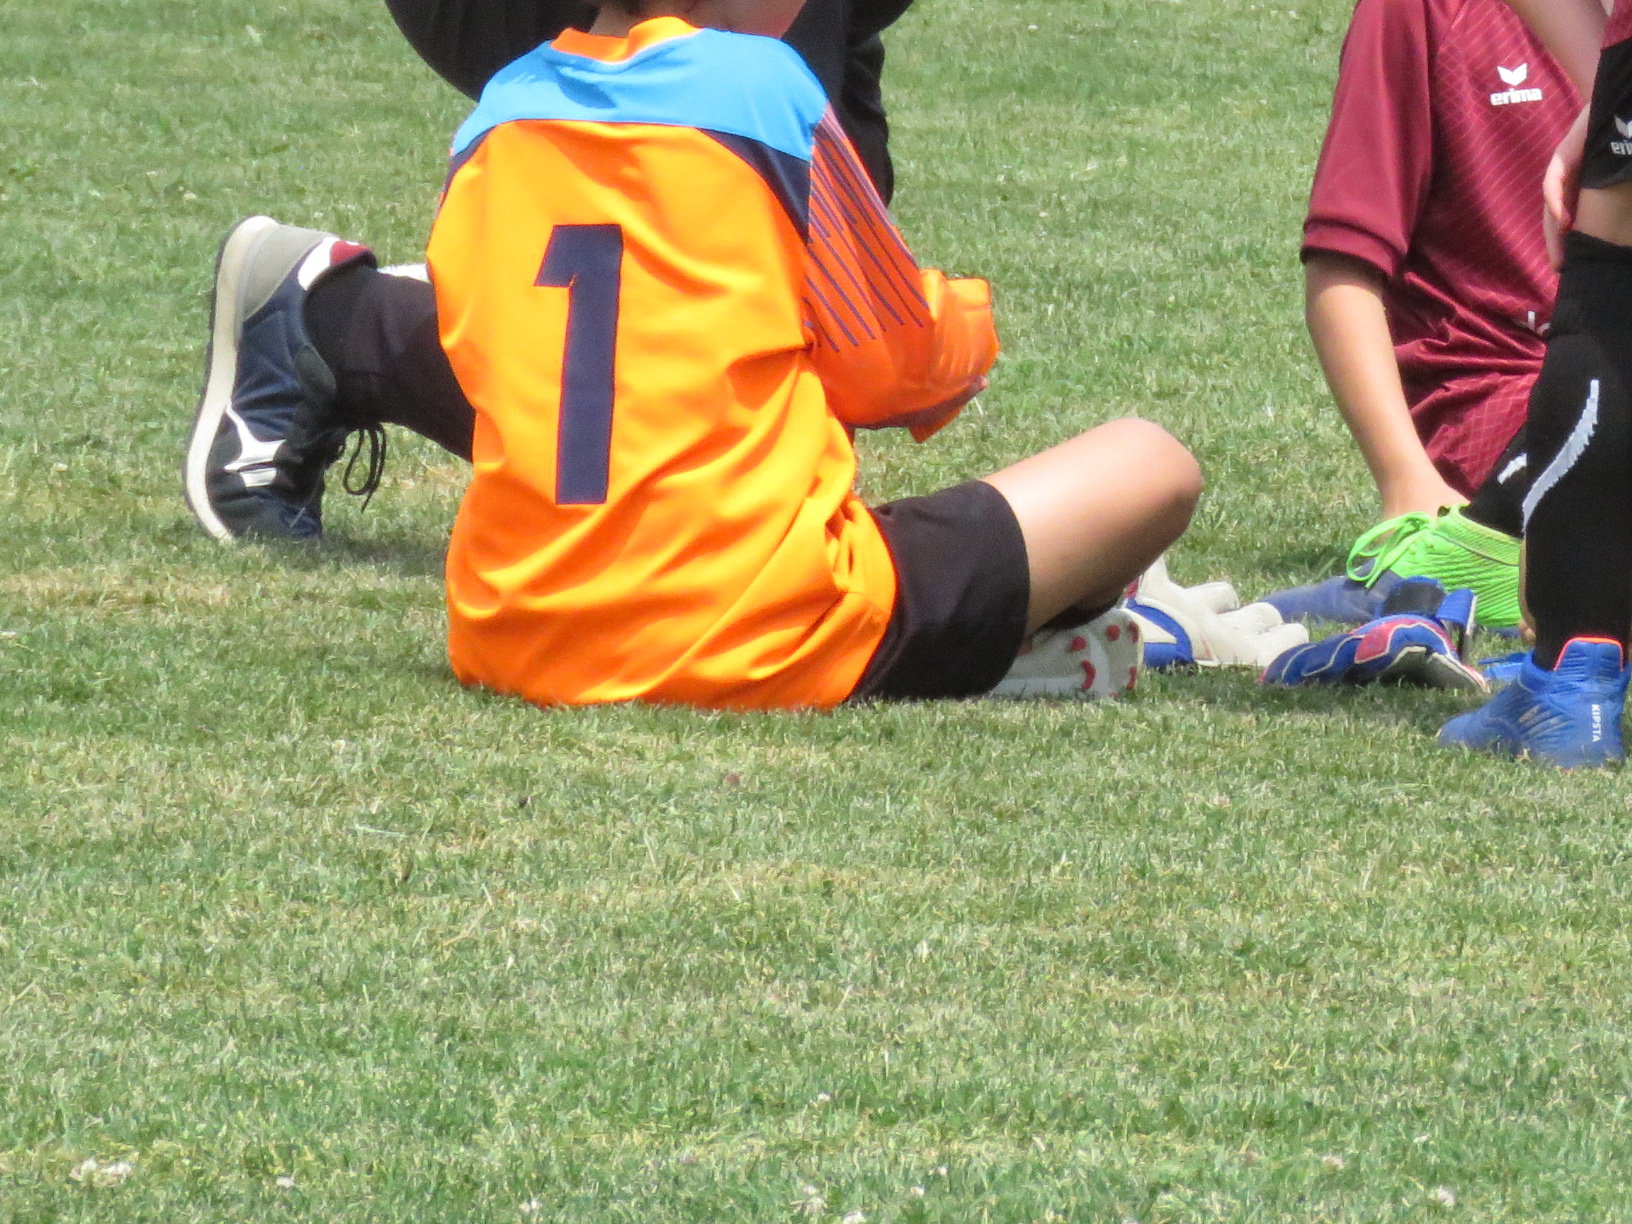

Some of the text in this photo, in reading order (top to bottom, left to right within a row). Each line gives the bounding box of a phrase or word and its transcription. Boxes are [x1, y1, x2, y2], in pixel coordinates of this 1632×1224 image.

[1490, 87, 1543, 107] erima
[533, 223, 624, 505] 1
[1591, 703, 1602, 743] KIPSTA
